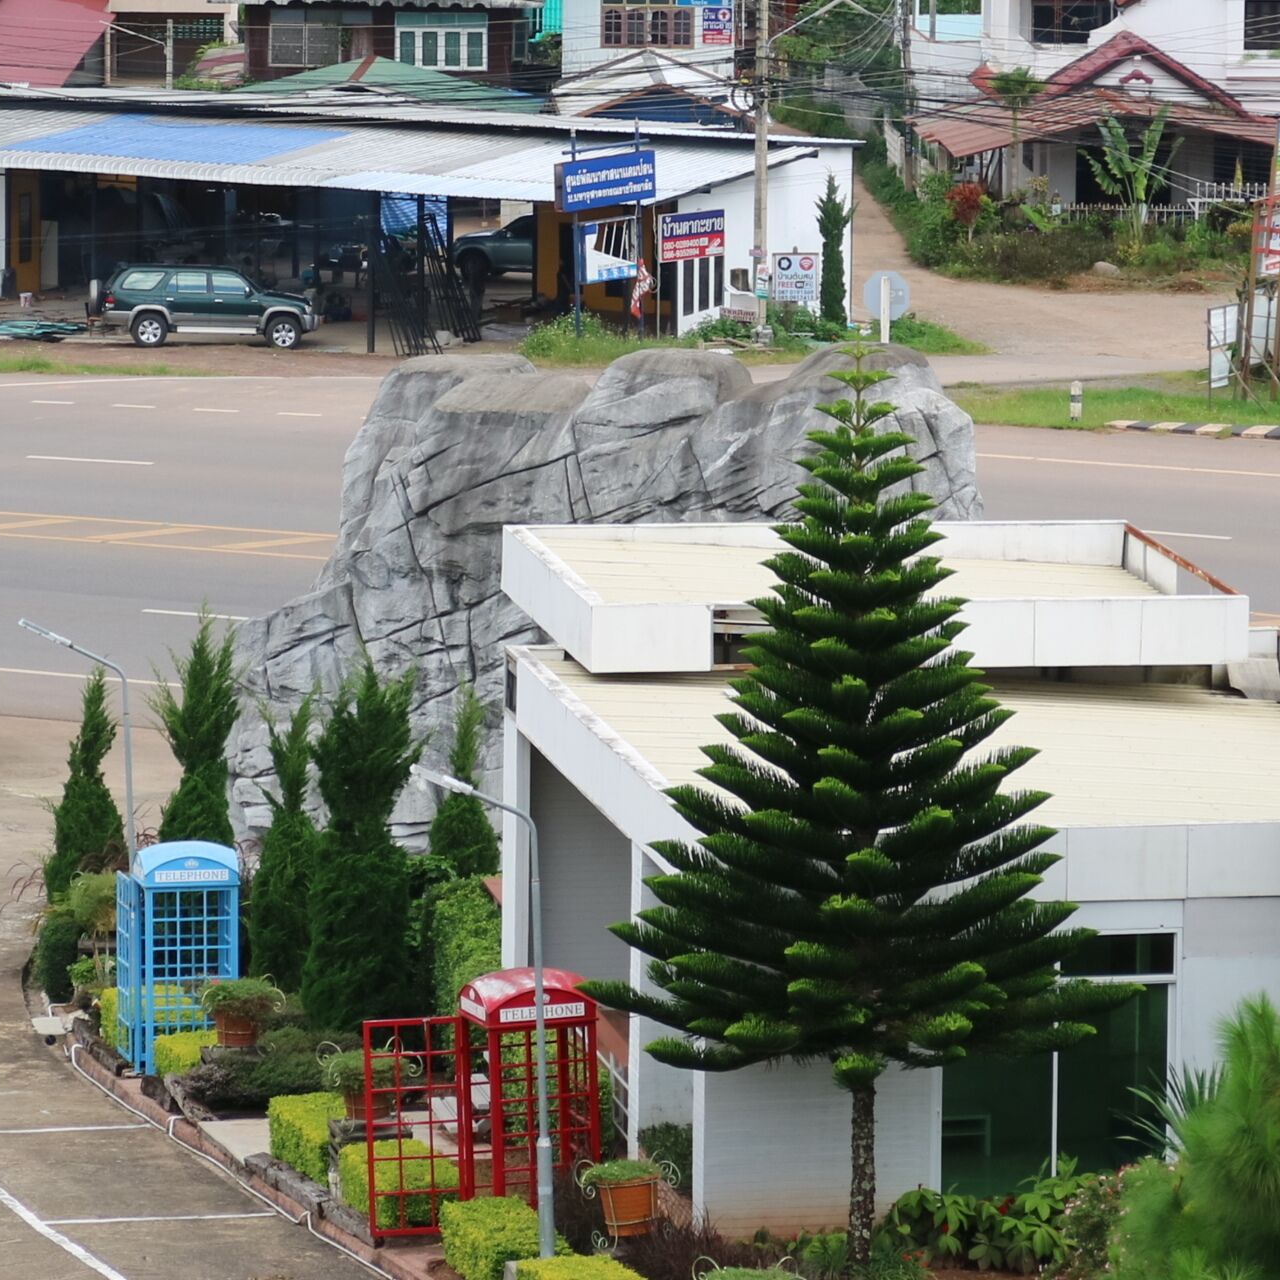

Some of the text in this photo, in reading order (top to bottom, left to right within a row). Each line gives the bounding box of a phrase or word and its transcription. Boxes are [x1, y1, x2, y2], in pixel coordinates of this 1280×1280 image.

[663, 217, 724, 237] บ้านตากะยาย
[157, 870, 227, 881] TELEPHONE
[502, 1005, 583, 1020] TELEHONE
